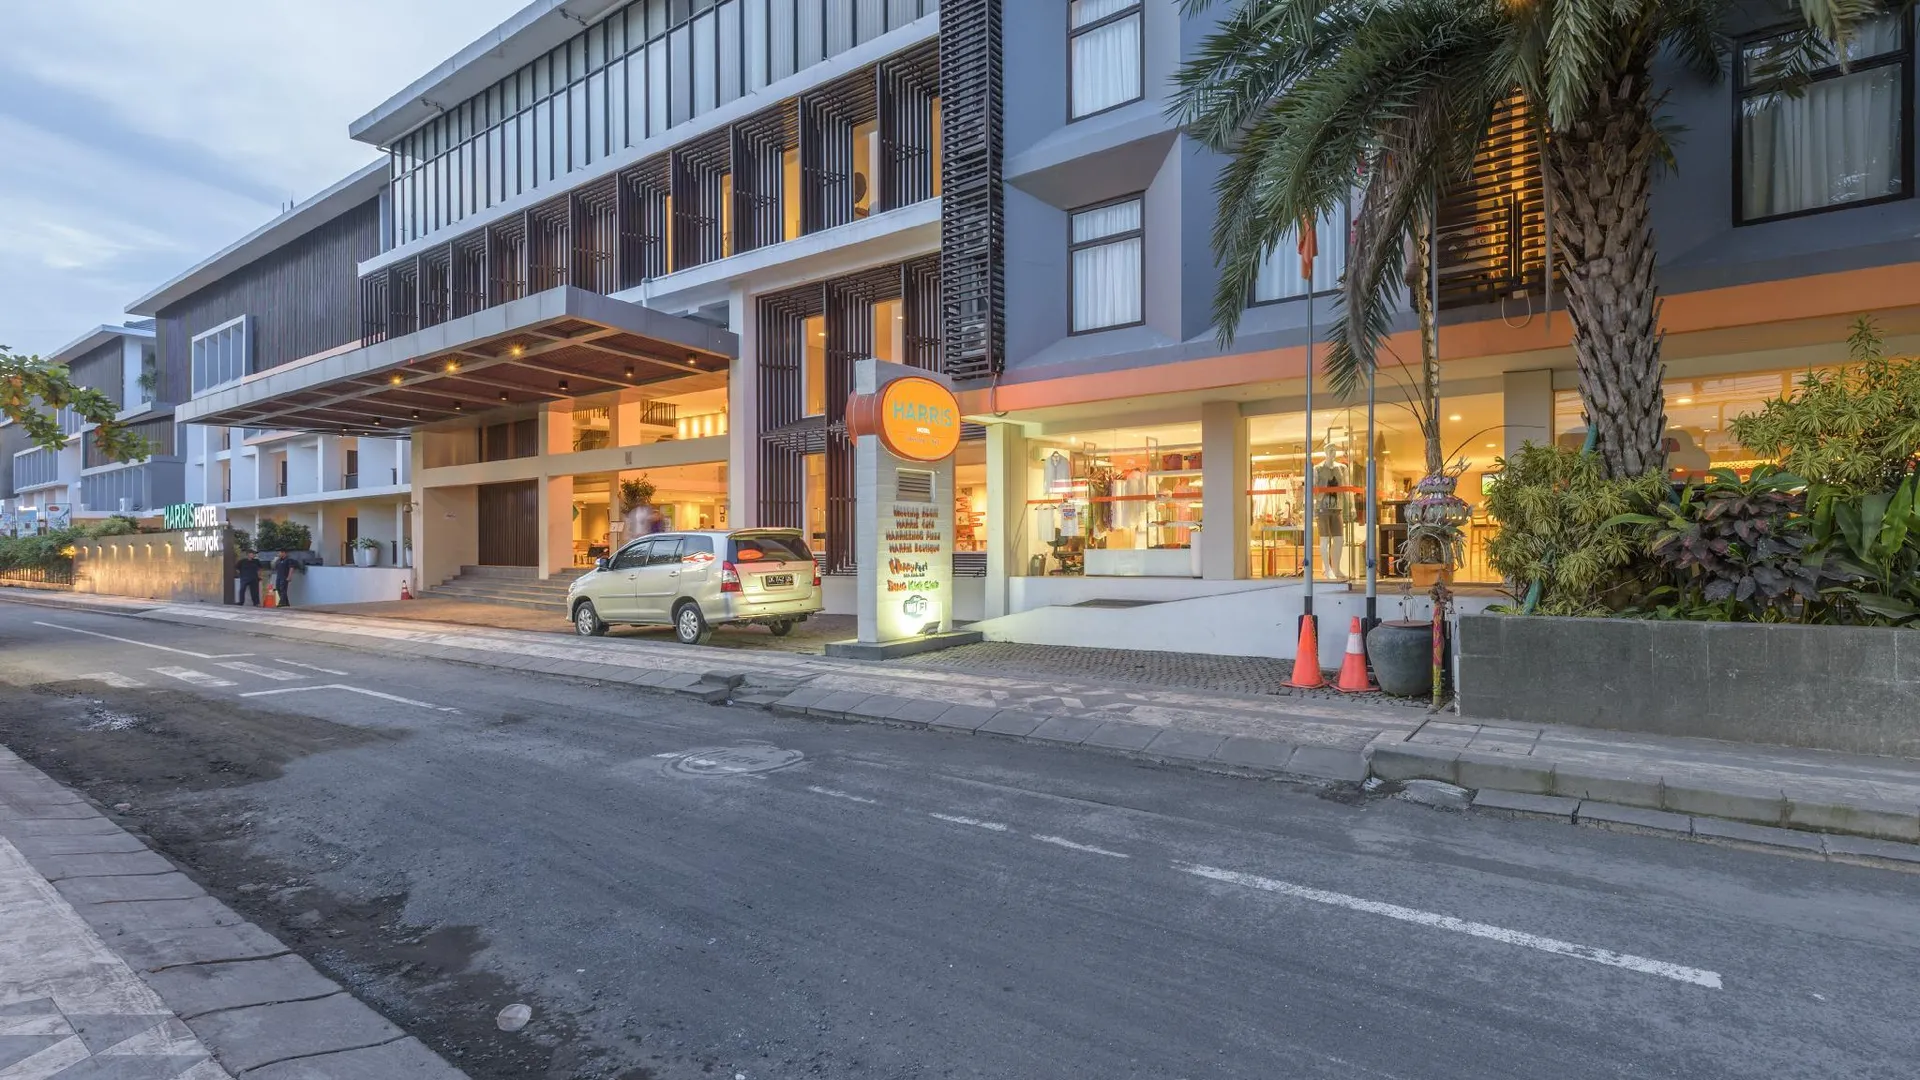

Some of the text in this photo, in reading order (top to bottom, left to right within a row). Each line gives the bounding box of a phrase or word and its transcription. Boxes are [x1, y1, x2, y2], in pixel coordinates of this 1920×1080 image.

[893, 401, 952, 427] HARRIS
[164, 503, 218, 528] HARRIS HOTEL
[184, 530, 219, 557] Seminyak
